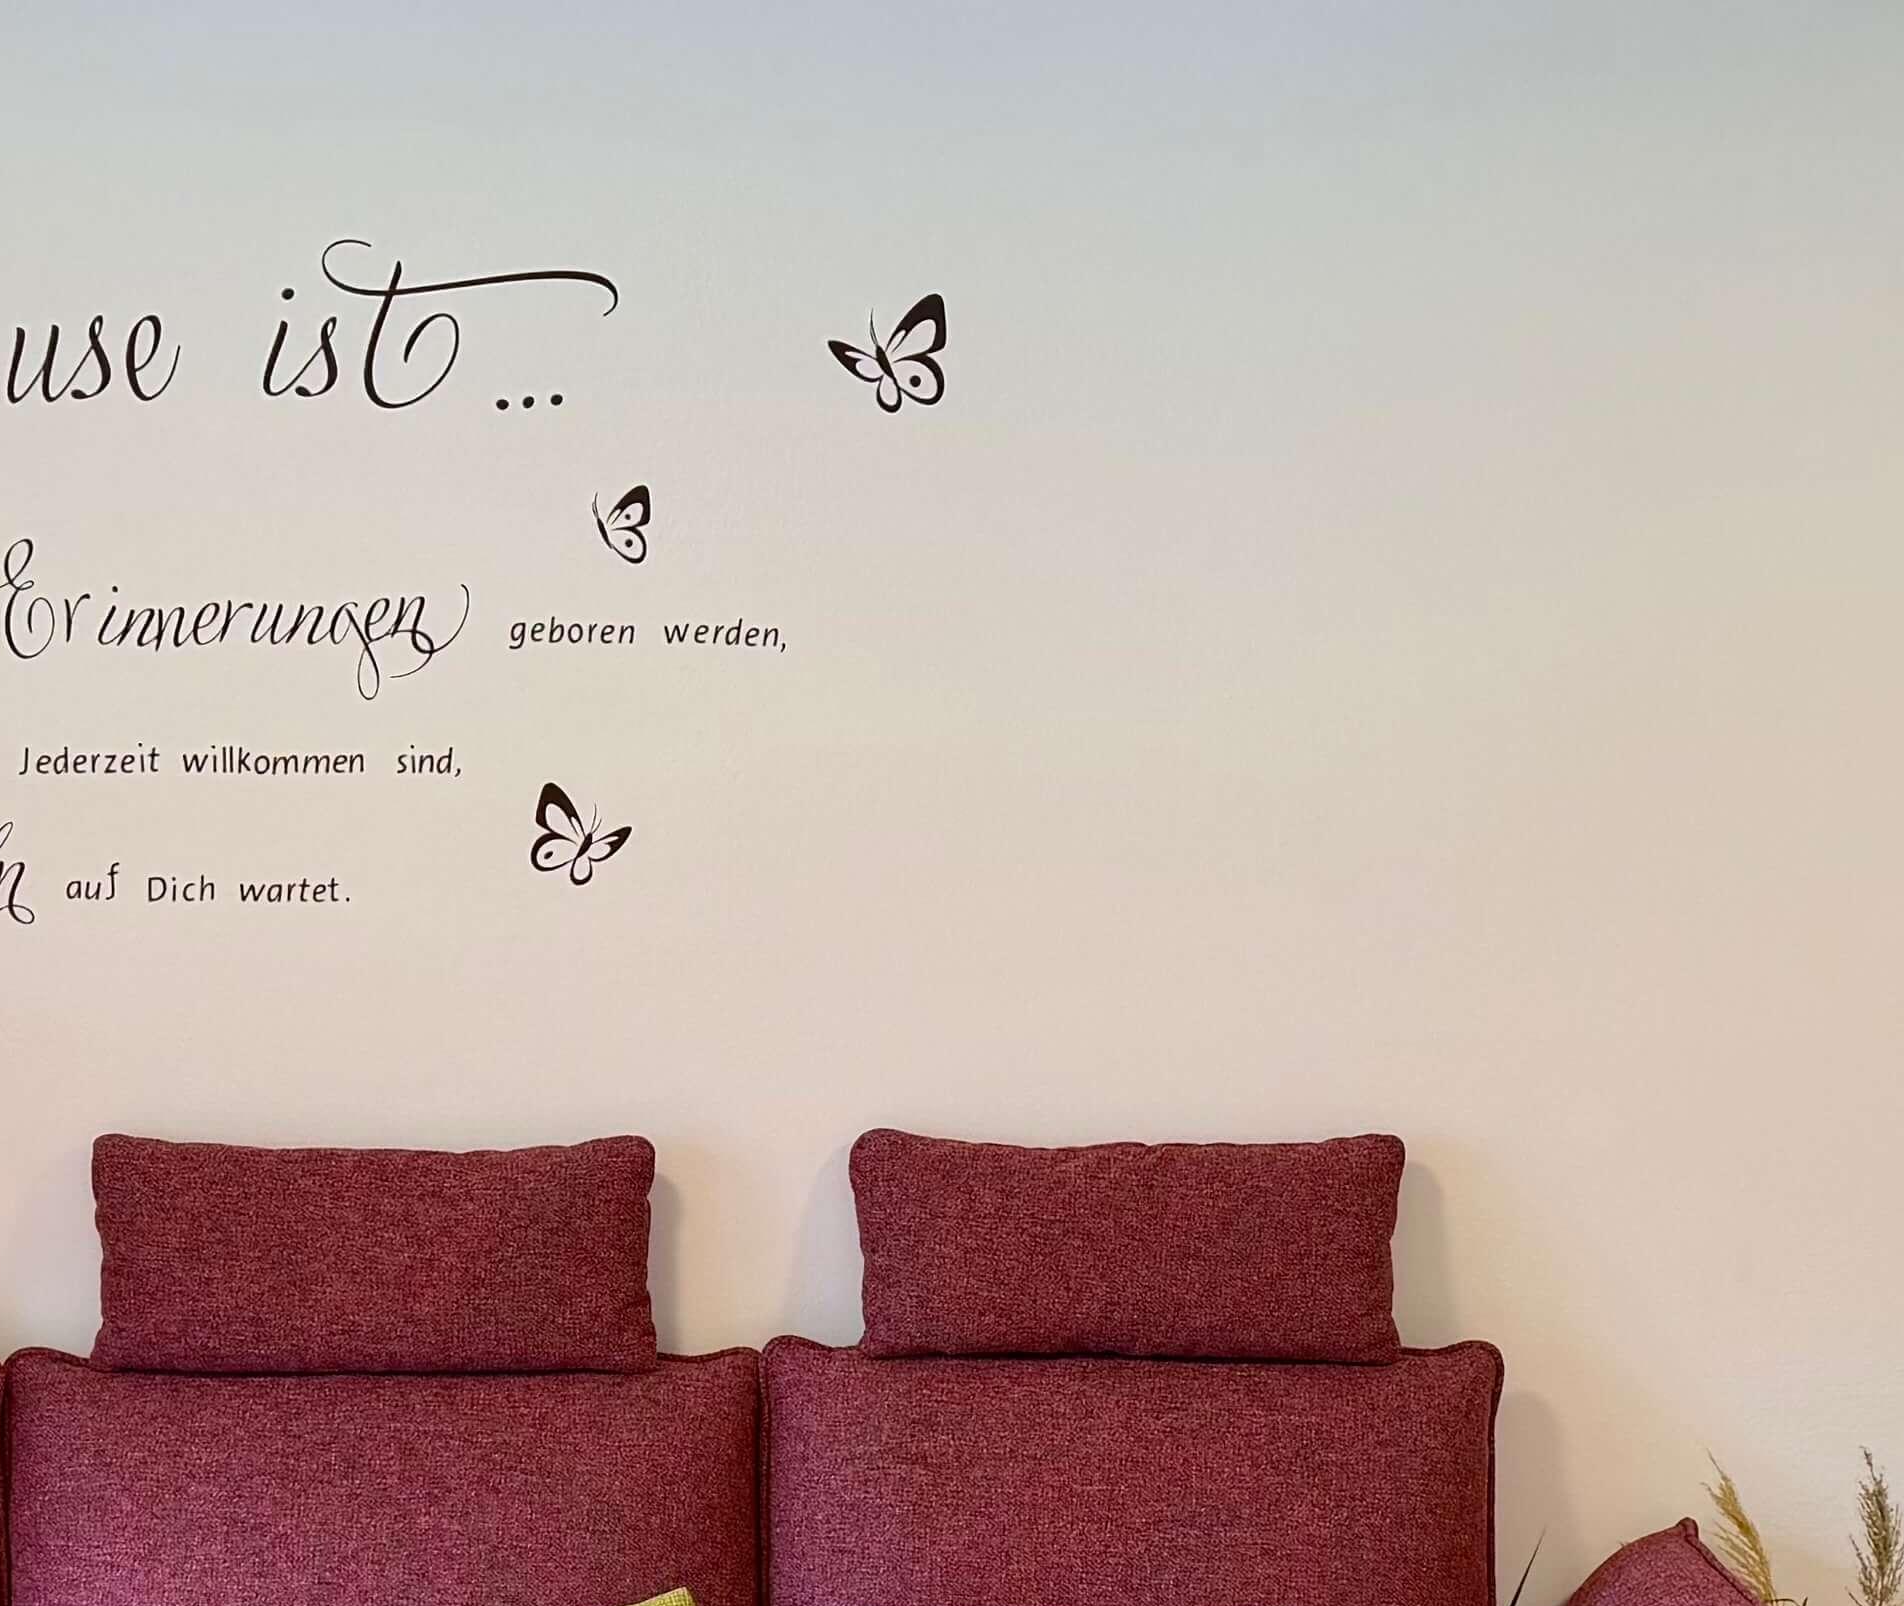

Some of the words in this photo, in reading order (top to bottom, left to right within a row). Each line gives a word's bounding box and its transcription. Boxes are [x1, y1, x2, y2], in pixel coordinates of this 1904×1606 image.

[507, 614, 637, 652] geboren
[662, 616, 788, 655] werden,
[17, 740, 162, 777] Jederzeit
[181, 743, 366, 776] willkommen
[395, 743, 463, 779] sind,
[64, 860, 122, 903] auf
[146, 872, 216, 904] Dich
[238, 873, 353, 904] wartet.
